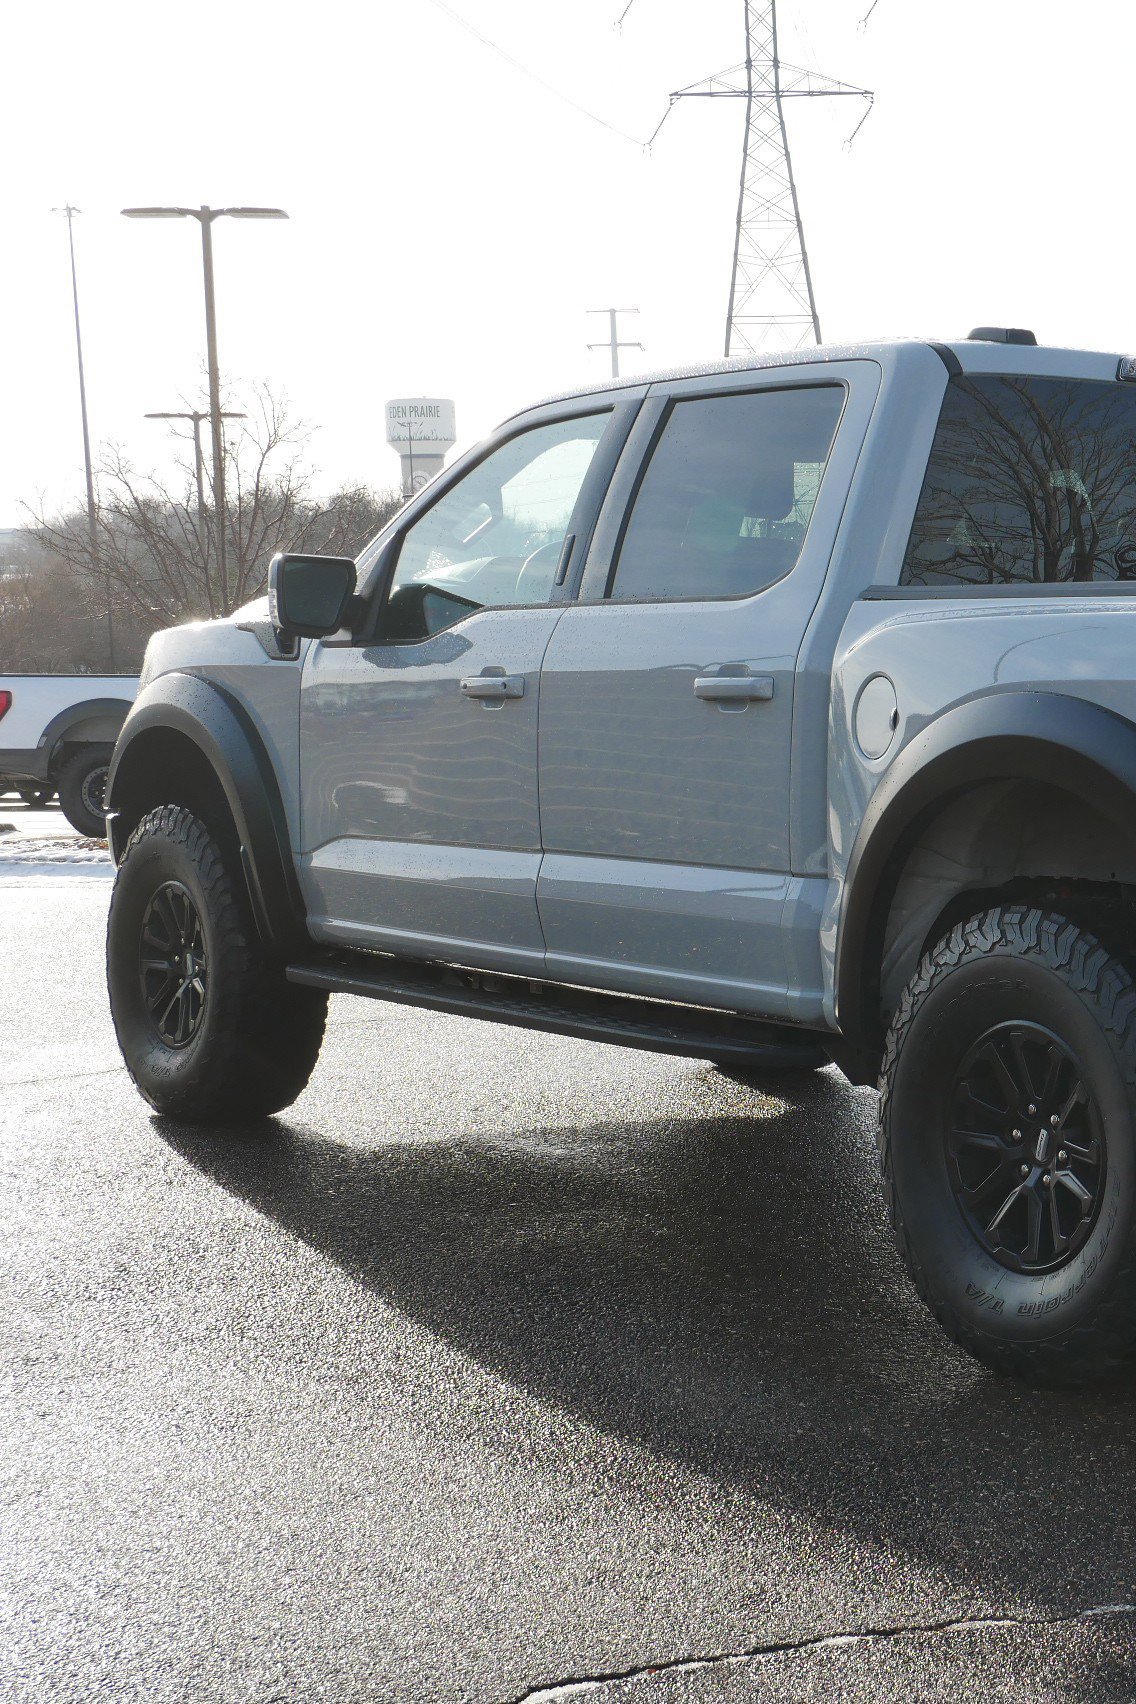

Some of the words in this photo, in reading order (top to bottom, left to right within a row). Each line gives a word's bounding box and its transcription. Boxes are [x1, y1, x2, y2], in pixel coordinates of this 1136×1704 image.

[389, 406, 407, 418] EDEN
[409, 405, 440, 418] PRAIRIE
[965, 1281, 1006, 1315] T/A
